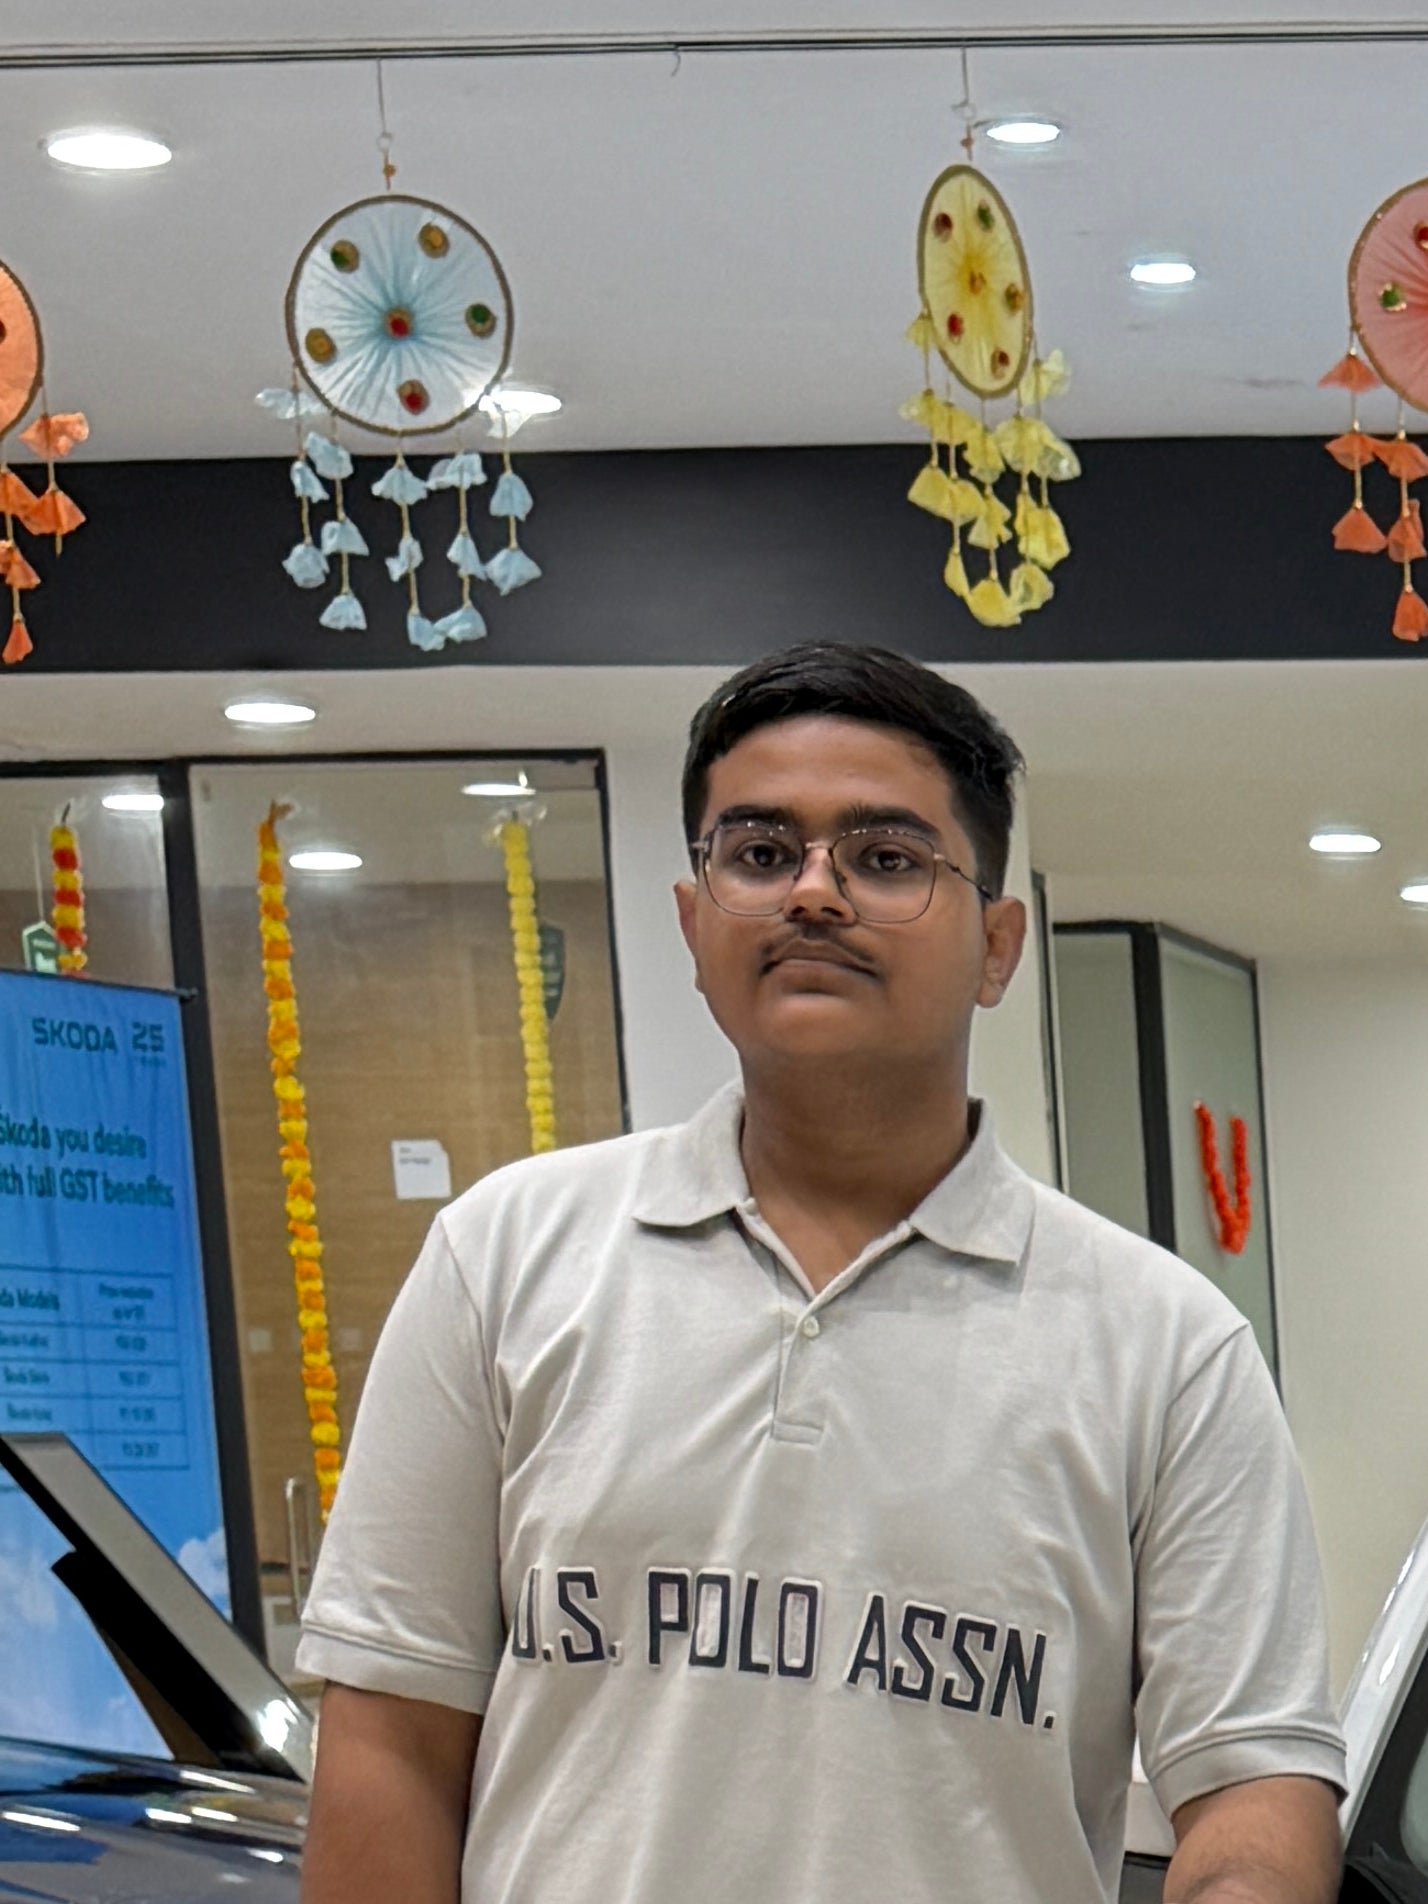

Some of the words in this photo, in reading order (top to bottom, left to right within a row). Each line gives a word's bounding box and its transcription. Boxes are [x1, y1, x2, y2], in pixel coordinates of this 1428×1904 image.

[132, 1021, 165, 1053] 25
[55, 1127, 89, 1160] you
[60, 1167, 98, 1203] GST
[646, 1566, 824, 1682] POLO
[844, 1590, 1057, 1732] ASSN.
